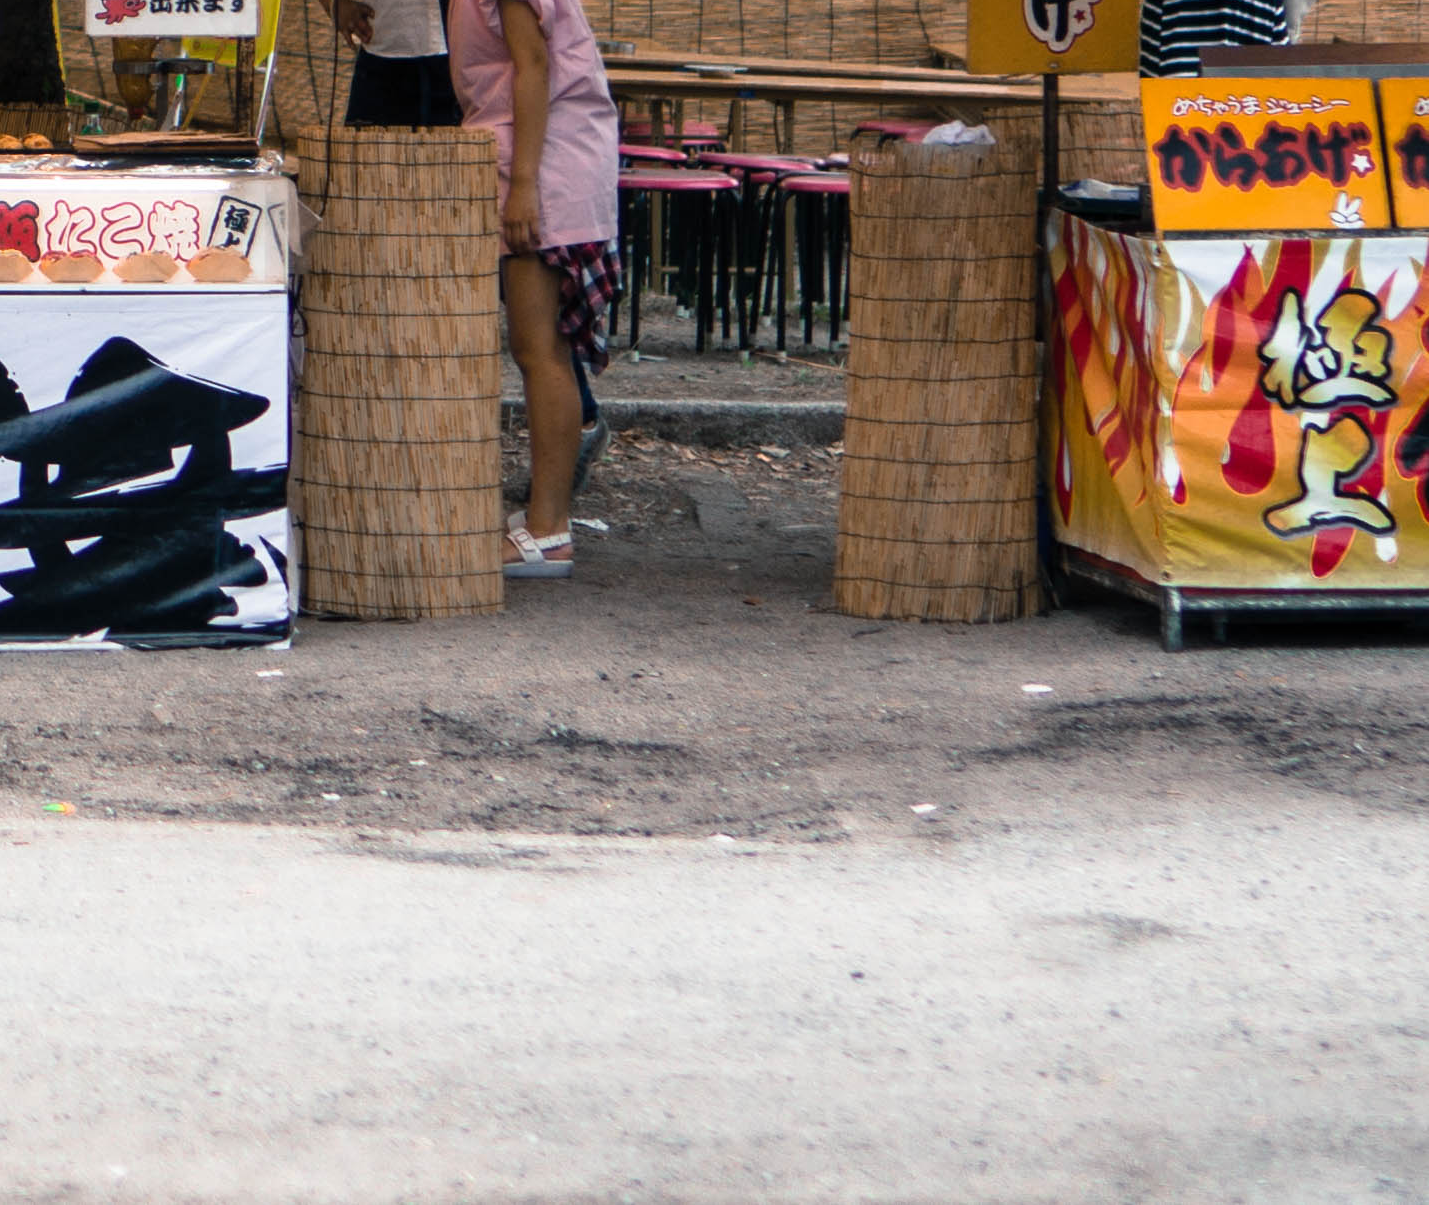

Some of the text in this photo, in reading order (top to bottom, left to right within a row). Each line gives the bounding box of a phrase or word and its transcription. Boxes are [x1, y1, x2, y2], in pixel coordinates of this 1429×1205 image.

[1172, 95, 1351, 116] めちゃうま ジューシー
[1155, 122, 1372, 189] からあげ
